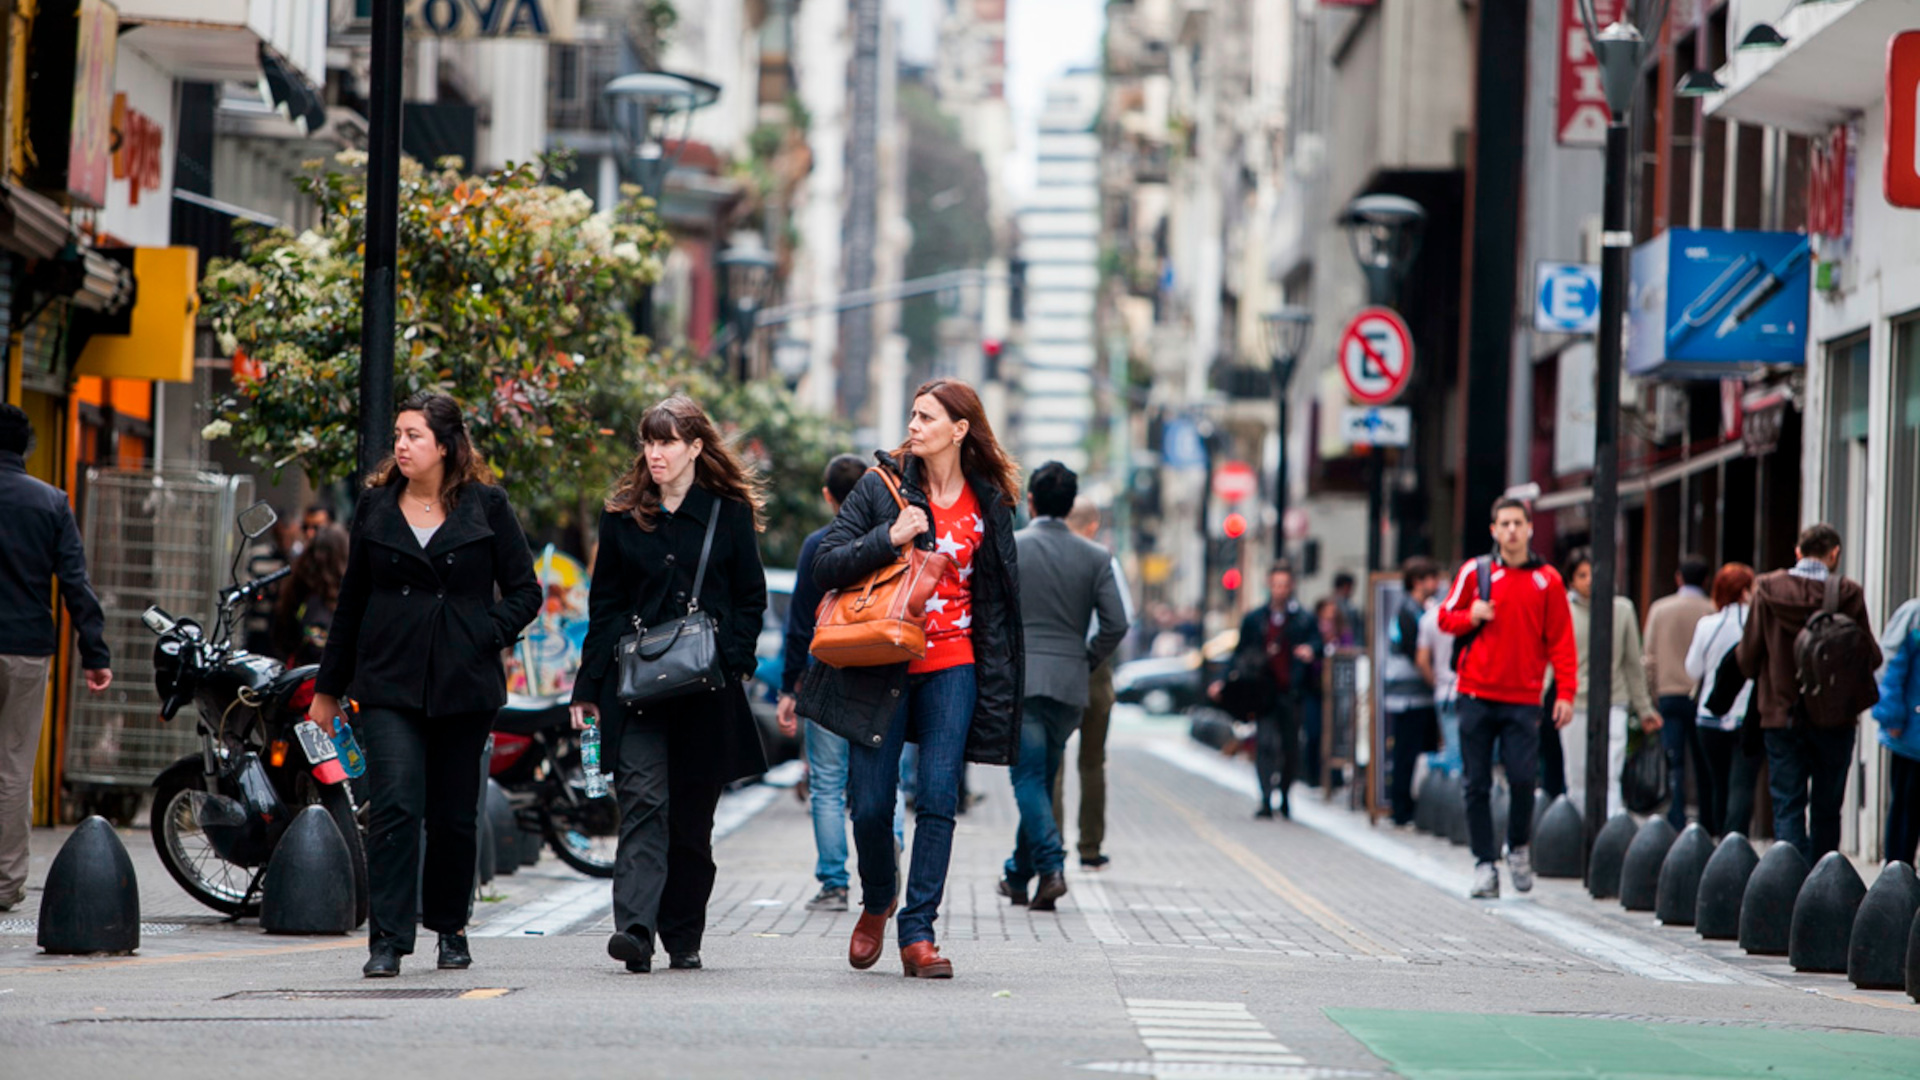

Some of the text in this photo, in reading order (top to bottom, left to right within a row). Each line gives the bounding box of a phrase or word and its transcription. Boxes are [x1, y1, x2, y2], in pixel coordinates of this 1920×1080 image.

[403, 0, 551, 36] OYA
[1552, 276, 1586, 318] E
[1361, 331, 1389, 379] E
